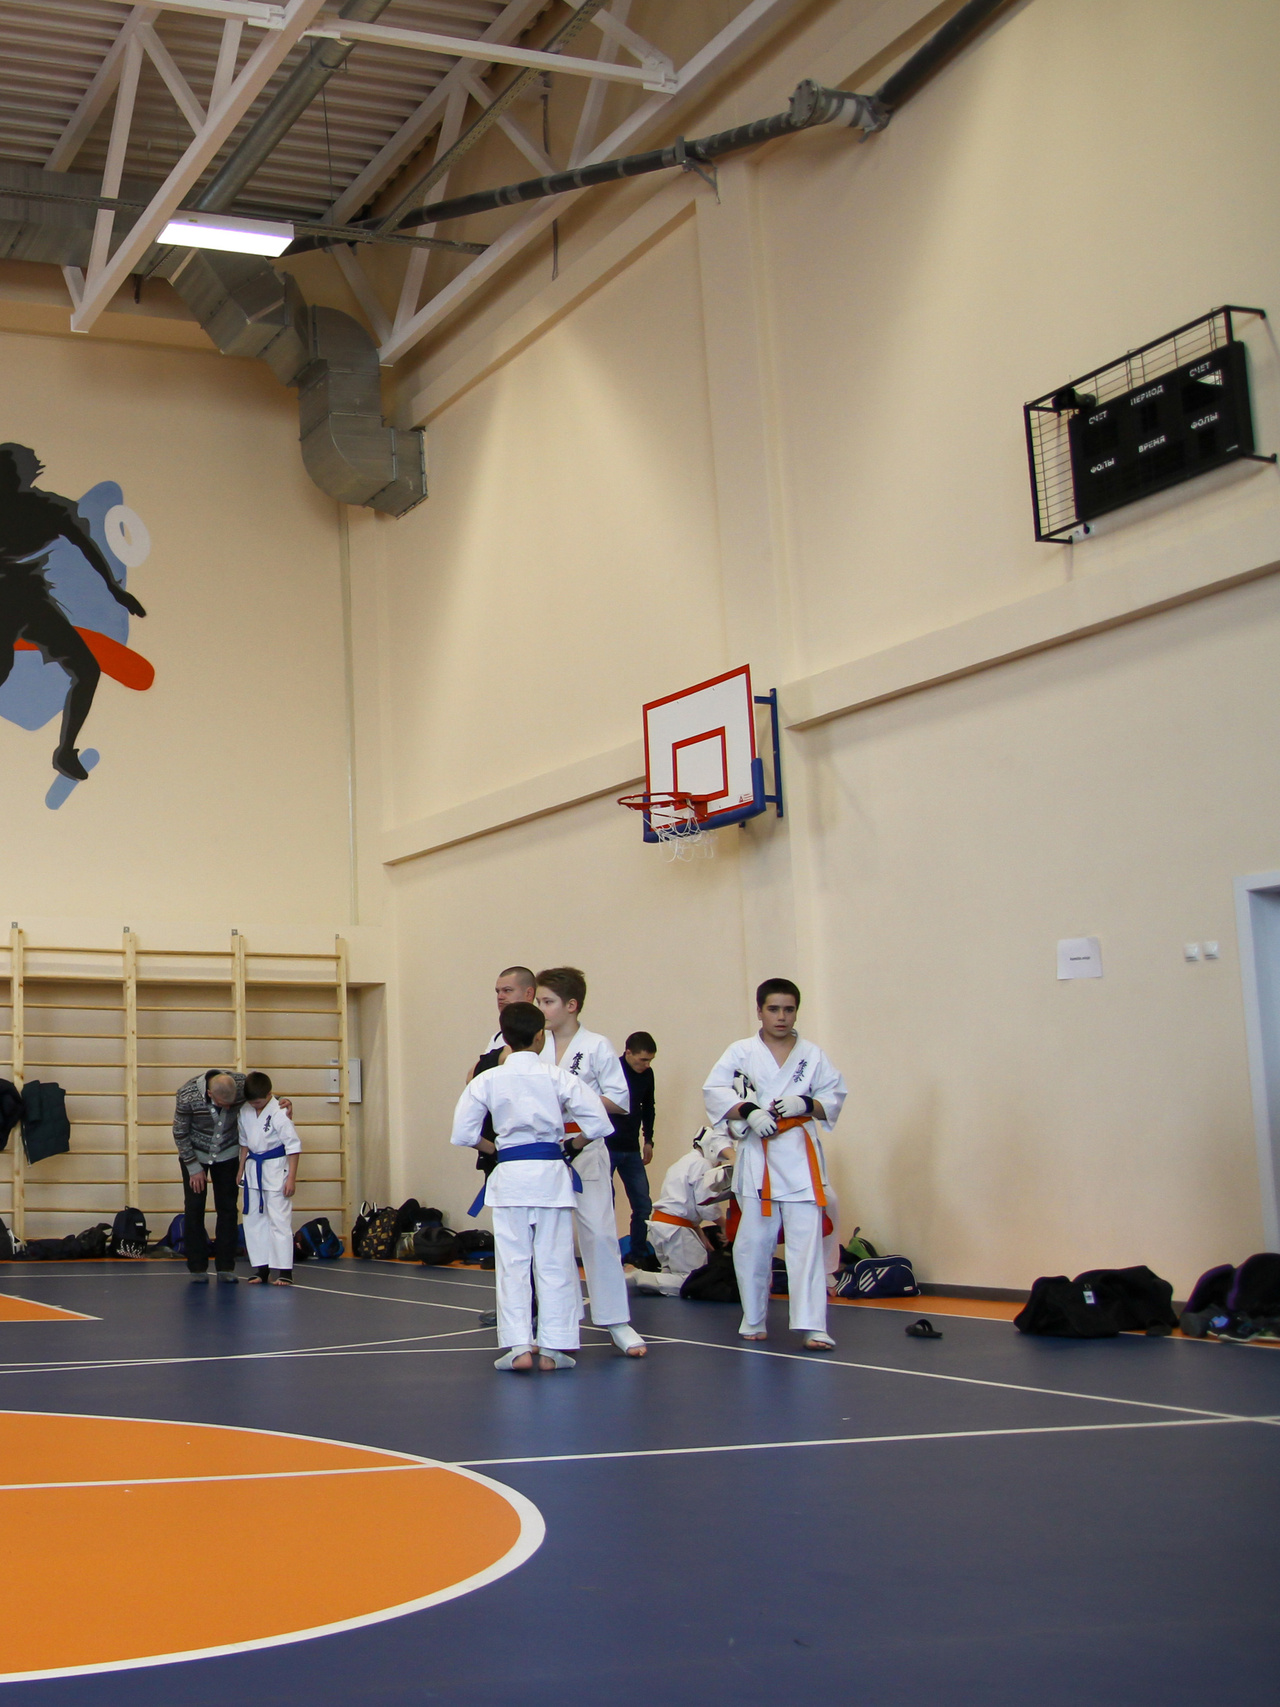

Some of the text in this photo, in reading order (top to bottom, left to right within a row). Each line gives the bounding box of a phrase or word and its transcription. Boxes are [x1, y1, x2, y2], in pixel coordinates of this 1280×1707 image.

[1130, 385, 1164, 406] ПЕРИОД
[1190, 412, 1218, 429] ФОЛЫ
[1138, 435, 1166, 453] ВРЕМЯ
[1090, 458, 1115, 473] ФОЛЫ
